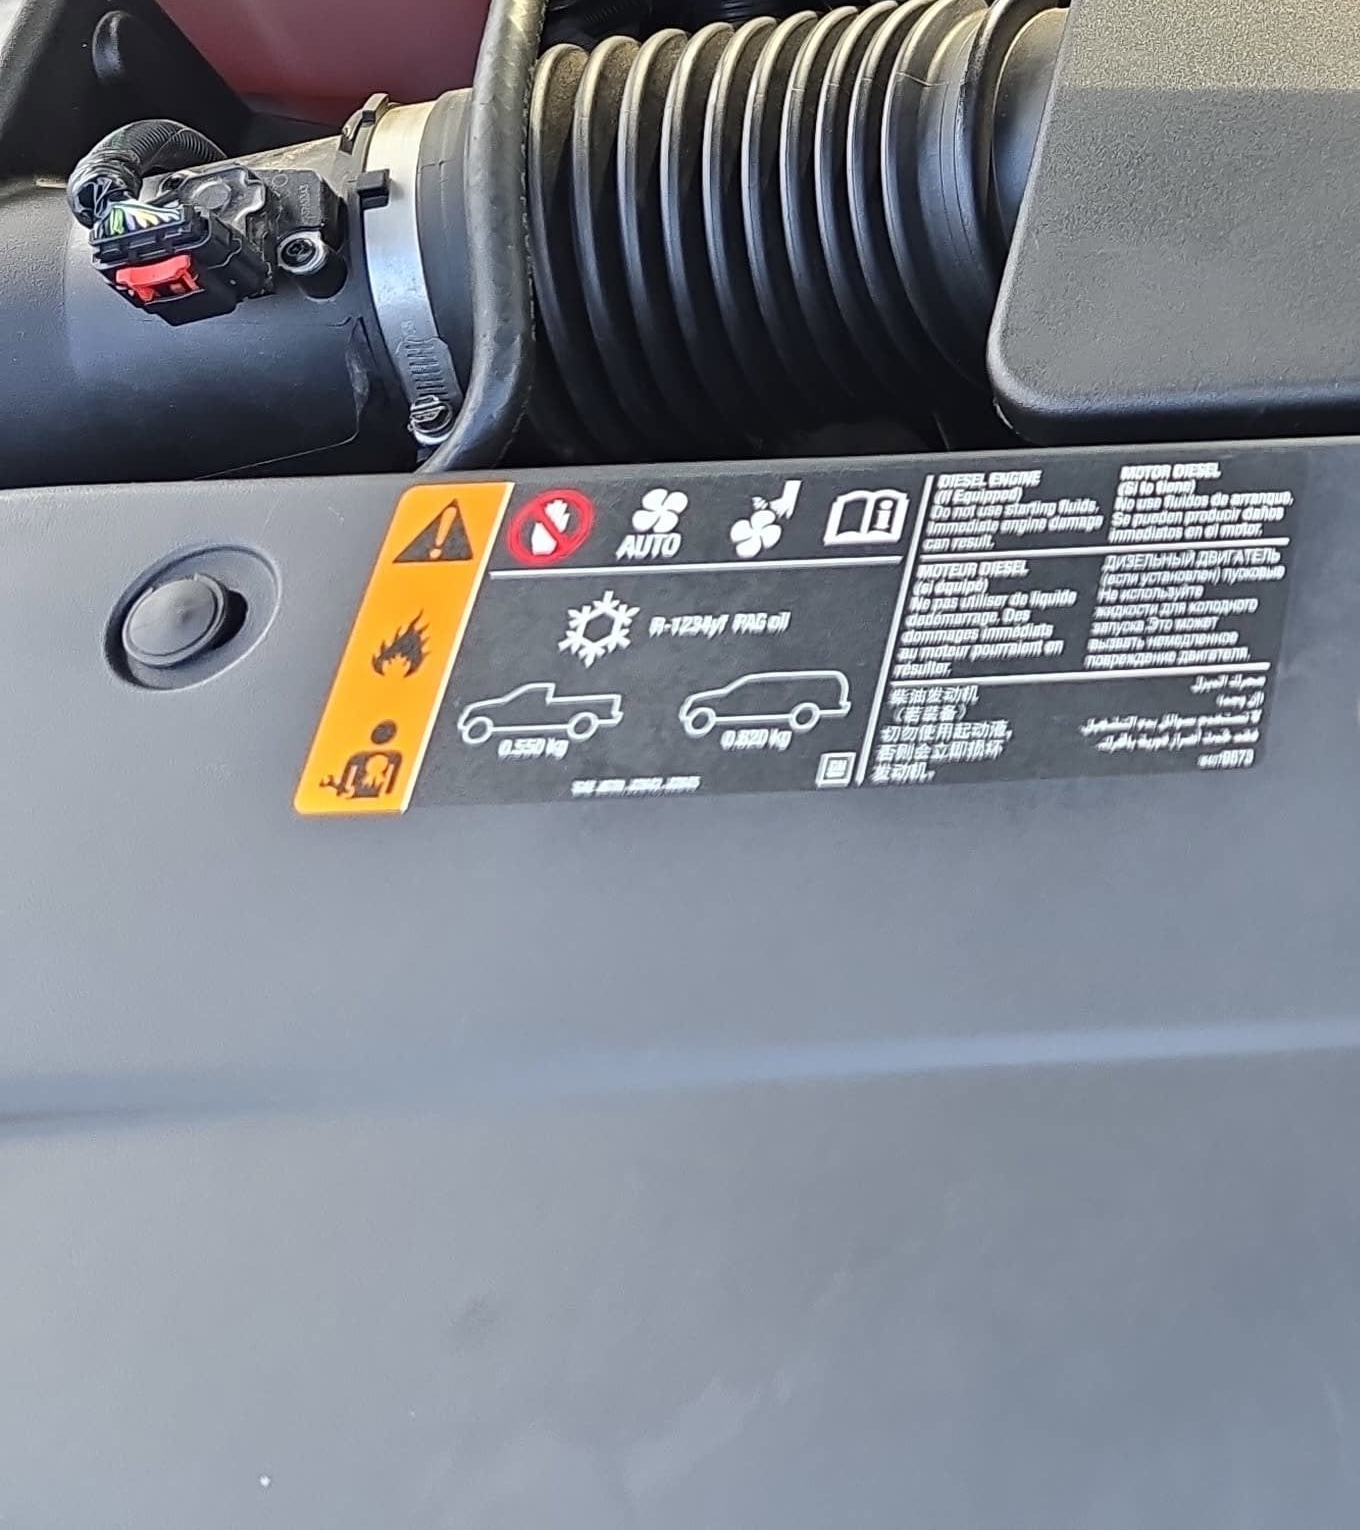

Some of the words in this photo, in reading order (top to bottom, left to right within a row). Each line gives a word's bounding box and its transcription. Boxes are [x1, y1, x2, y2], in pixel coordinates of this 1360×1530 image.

[937, 472, 988, 492] DIESEL
[988, 469, 1043, 488] ENGINE
[1120, 464, 1172, 483] MOTOR
[1172, 462, 1222, 481] DIESEL
[951, 484, 1024, 507] Equipped)
[1114, 496, 1136, 512] No
[1135, 497, 1162, 511] use
[1163, 493, 1210, 512] fluidos
[1209, 492, 1230, 507] de
[929, 504, 952, 520] Do
[951, 503, 977, 519] not
[974, 504, 1003, 521] use
[1003, 500, 1058, 522] starting
[1111, 512, 1131, 527] Se
[1131, 511, 1184, 529] pueden
[1183, 505, 1242, 528] producir
[925, 515, 1000, 537] Immediate
[1000, 517, 1048, 536] engine
[1047, 515, 1104, 532] damage
[616, 533, 682, 560] AUTO
[922, 537, 950, 552] can
[916, 562, 978, 580] MOTEUR
[978, 559, 1029, 581] DIESEL
[1101, 549, 1196, 574] ДИЗЕЛЬНЫЙ
[1194, 547, 1281, 569] ДВИГАТЕЛЬ
[908, 596, 931, 613] Ne
[930, 597, 959, 614] pas
[959, 593, 1009, 611] utiliser
[1006, 591, 1029, 610] de
[1025, 589, 1078, 612] liquide
[1096, 587, 1119, 603] Не
[649, 612, 729, 640] R-1234yf
[732, 612, 769, 637] PAG
[767, 612, 791, 635] oil
[1001, 607, 1032, 625] Des
[900, 628, 980, 646] dommages
[897, 647, 919, 662] au
[918, 644, 971, 664] moteur
[969, 639, 1044, 662] pourraient
[1043, 640, 1064, 655] en
[888, 684, 979, 709] 柴油发动机
